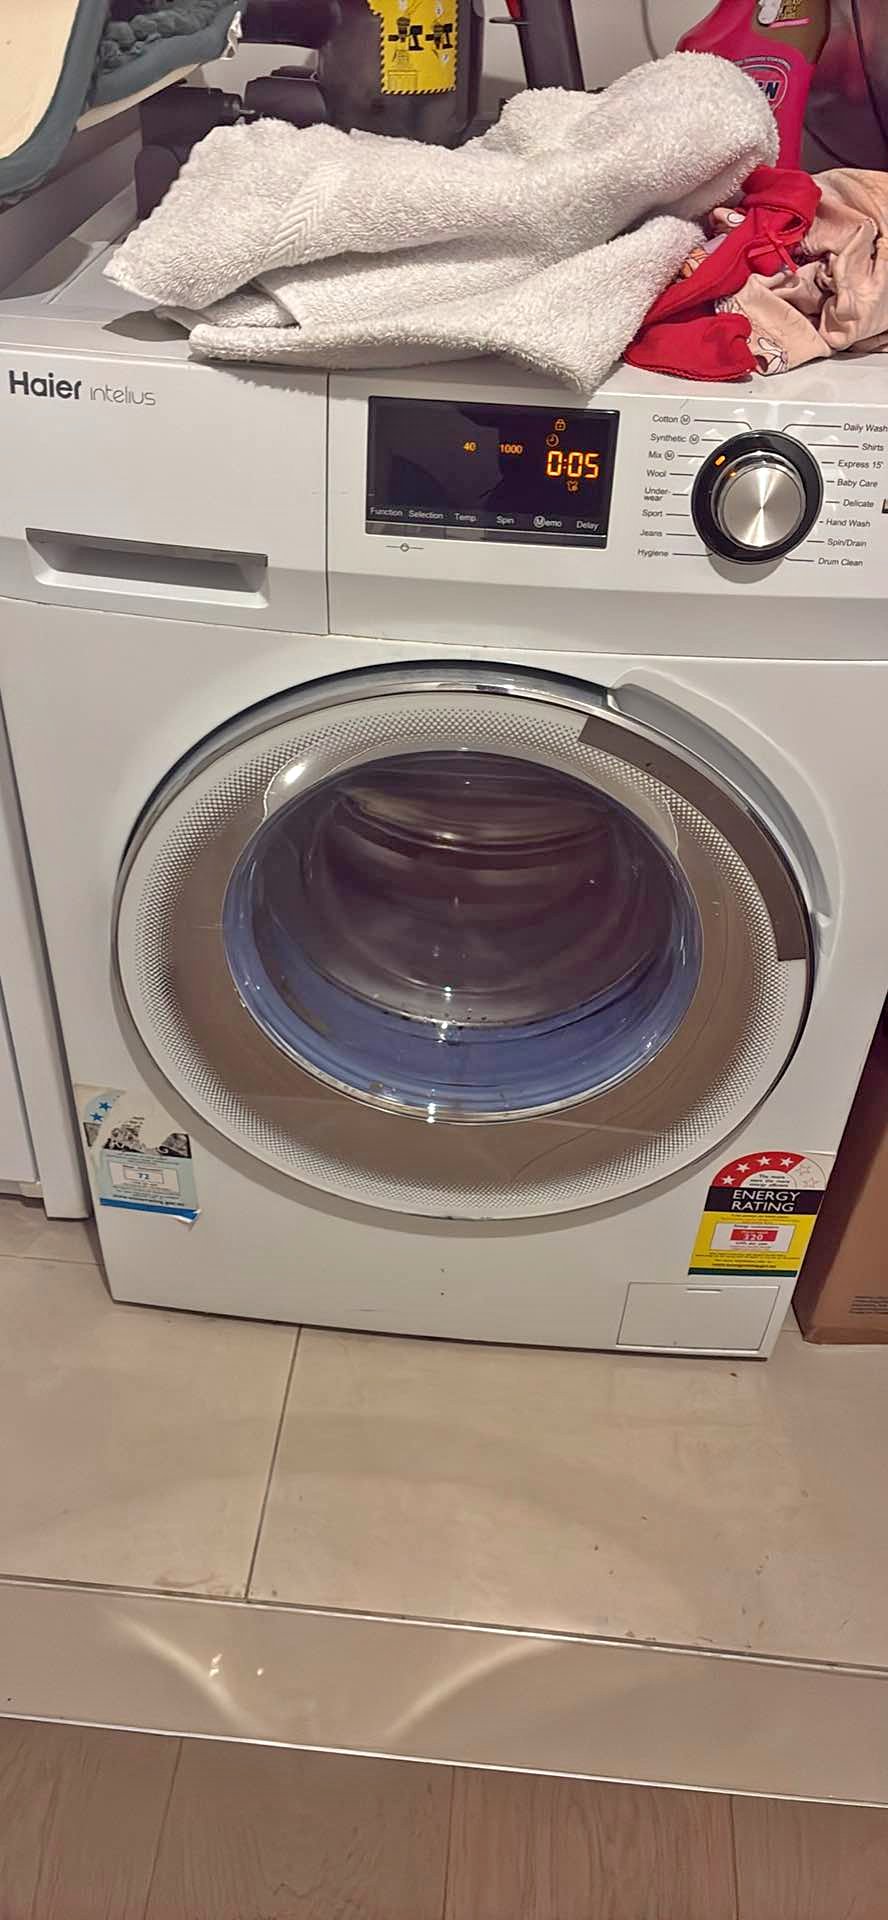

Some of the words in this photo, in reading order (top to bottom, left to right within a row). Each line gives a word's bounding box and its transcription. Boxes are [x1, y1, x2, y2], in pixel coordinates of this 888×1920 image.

[8, 370, 82, 400] Haier
[89, 384, 157, 406] intelius
[652, 414, 679, 423] Cotton
[843, 423, 864, 433] Daily
[865, 424, 888, 432] Wash
[650, 433, 687, 443] Synthetic
[463, 441, 477, 452] 40
[500, 444, 523, 454] 1000
[862, 442, 884, 451] Shirts
[648, 451, 662, 459] Mix
[546, 450, 600, 478] 0:05
[838, 459, 870, 469] Express
[646, 469, 667, 478] Wool
[837, 478, 857, 488] Baby
[858, 479, 878, 488] Care
[644, 487, 672, 495] Under-
[843, 499, 875, 508] Delicate
[641, 508, 663, 518] Sport
[370, 506, 403, 517] Function
[408, 510, 444, 520] Selection
[496, 515, 515, 525] Spin
[576, 520, 600, 532] Delay
[826, 518, 847, 527] Hand
[849, 519, 871, 527] Wash
[640, 529, 663, 537] Jeans
[827, 537, 867, 548] Spin/Drain
[637, 548, 669, 558] Hygiene
[818, 557, 839, 565] Drum
[841, 558, 864, 566] Clean
[732, 1189, 801, 1202] ENERGY
[731, 1200, 795, 1213] RATING
